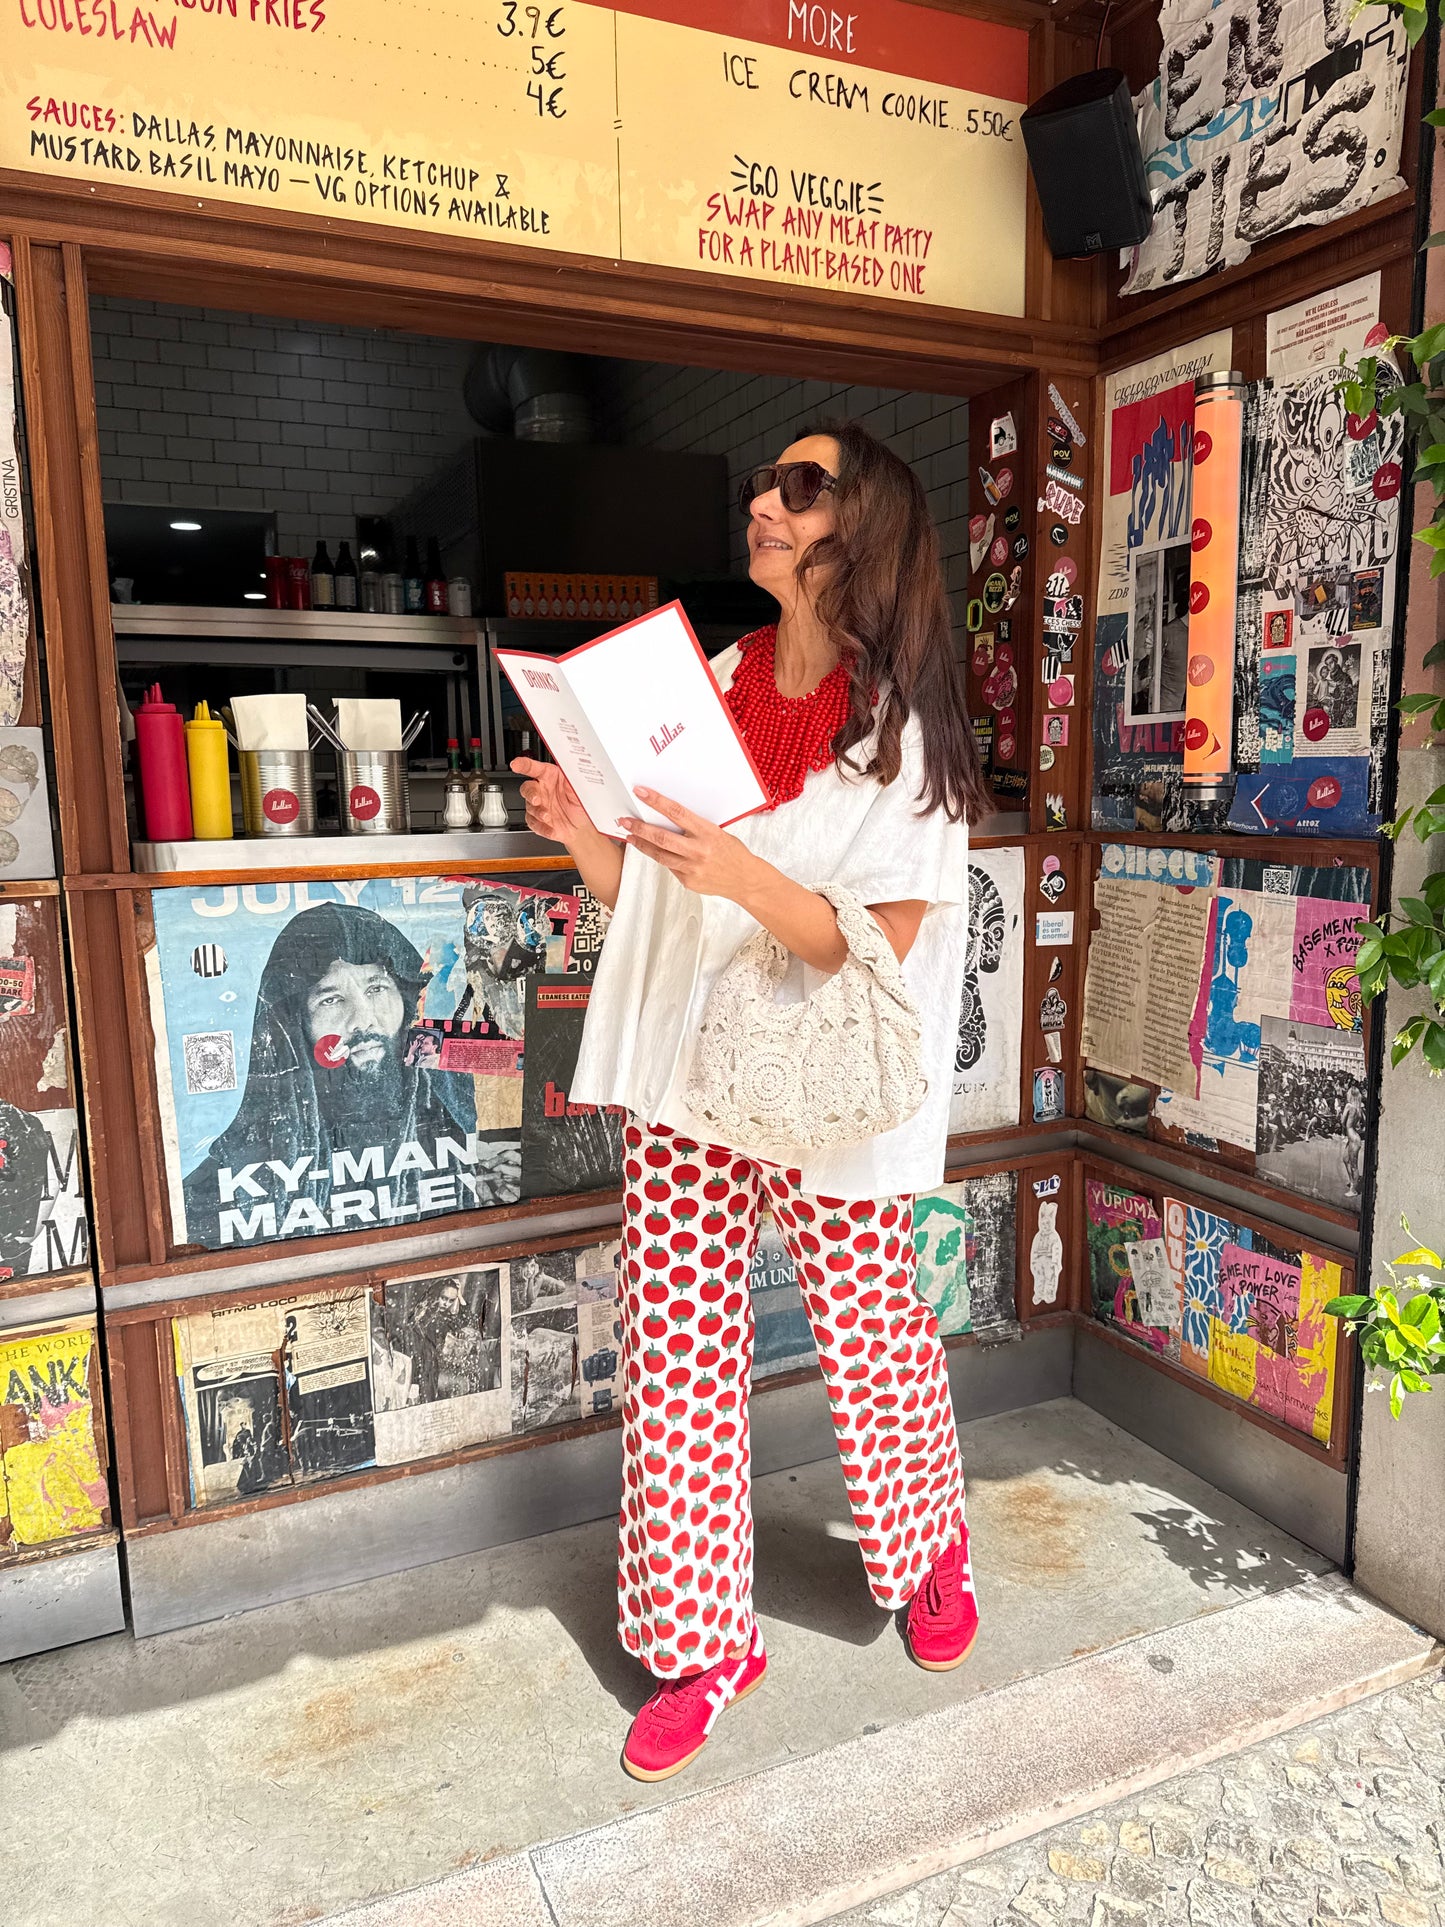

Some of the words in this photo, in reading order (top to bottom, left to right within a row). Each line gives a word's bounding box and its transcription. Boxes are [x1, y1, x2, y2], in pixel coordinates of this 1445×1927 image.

[497, 5, 566, 39] 3.9€
[787, 0, 859, 54] MORE
[531, 47, 567, 80] 5€
[527, 83, 567, 119] 4€
[723, 52, 759, 90] ICE
[789, 70, 869, 113] CREAM
[881, 92, 949, 128] COOKIE
[25, 96, 126, 134] SAUCES:
[382, 155, 480, 192] KETCHUP
[148, 154, 218, 183] BASIL
[223, 167, 281, 194] MAYO
[315, 172, 347, 203] VG
[355, 180, 440, 217] OPTIONS
[448, 200, 552, 236] AVAILABLE
[749, 162, 779, 199] GO
[790, 169, 865, 216] VEGGIE
[706, 192, 775, 227] SWAP
[781, 206, 823, 241] ANY
[830, 213, 879, 248] MEAT
[884, 222, 933, 260] PATTY
[698, 228, 735, 265] FOR
[738, 235, 756, 269] A
[760, 239, 885, 288] PLANT-BASED
[890, 262, 926, 297] ONE
[1144, 353, 1214, 385] CONUNDRUM
[1107, 586, 1129, 601] ZDB
[521, 668, 560, 693] DRINKS
[1041, 920, 1064, 929] liberal
[1041, 931, 1070, 939] anormal
[1293, 916, 1364, 974] BASEMENT
[538, 992, 570, 1000] LEBANESE
[217, 1132, 479, 1205] KY-MAN
[1239, 1280, 1279, 1304] POWER
[1266, 1267, 1300, 1288] LOVE
[212, 1304, 257, 1319] RITMO
[261, 1296, 298, 1309] LOCO
